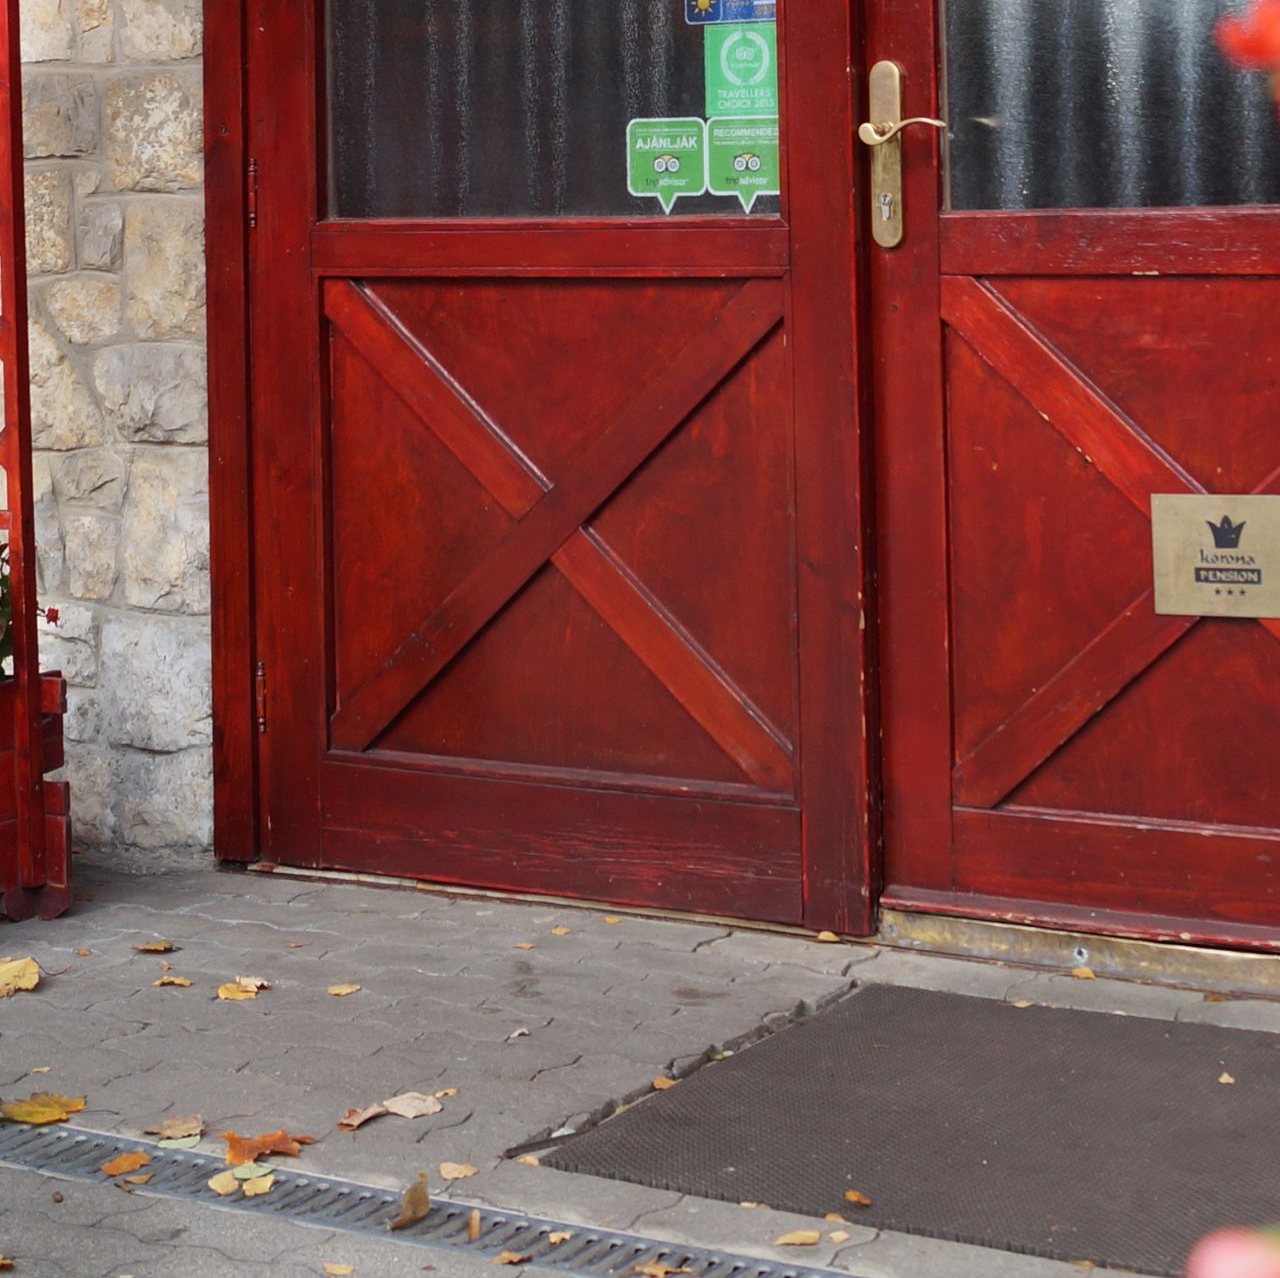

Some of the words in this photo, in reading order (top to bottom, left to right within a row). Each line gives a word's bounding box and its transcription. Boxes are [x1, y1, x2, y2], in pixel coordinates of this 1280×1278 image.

[718, 99, 752, 109] CHOICE
[636, 134, 697, 150] AJÁNLJÁK
[1200, 548, 1256, 566] korona
[1199, 569, 1259, 583] PENSION
